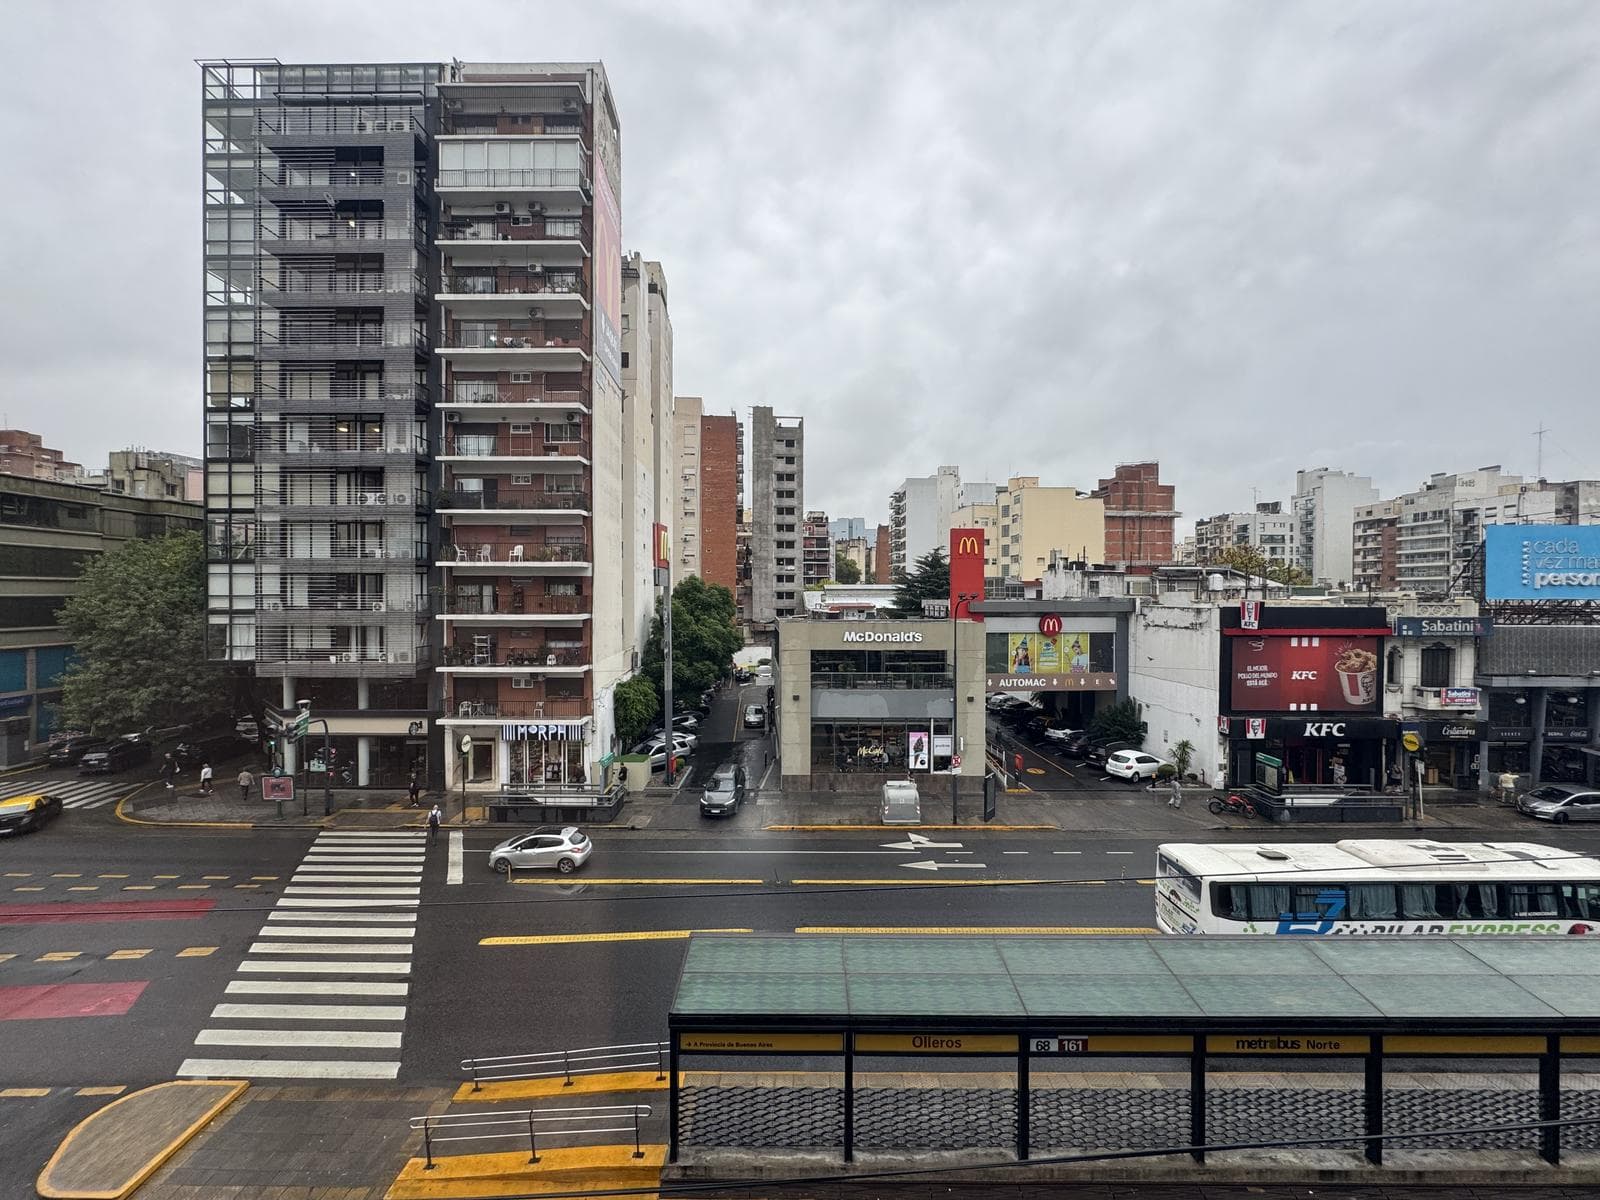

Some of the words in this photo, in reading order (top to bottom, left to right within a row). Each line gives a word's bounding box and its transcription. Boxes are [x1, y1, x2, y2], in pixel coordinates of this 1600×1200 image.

[1533, 538, 1578, 554] cada
[1535, 557, 1563, 569] vez
[1421, 620, 1474, 632] Sabatini
[843, 631, 923, 642] McDonald's
[1291, 671, 1317, 680] KFC
[999, 678, 1047, 687] AUTOMAC
[518, 725, 567, 740] MORPH
[1303, 723, 1346, 737] KFC
[912, 1036, 962, 1048] Olleros
[1035, 1040, 1050, 1051] 68
[1062, 1040, 1083, 1051] 161
[1236, 1037, 1301, 1049] metrobus
[1306, 1040, 1340, 1049] Norte
